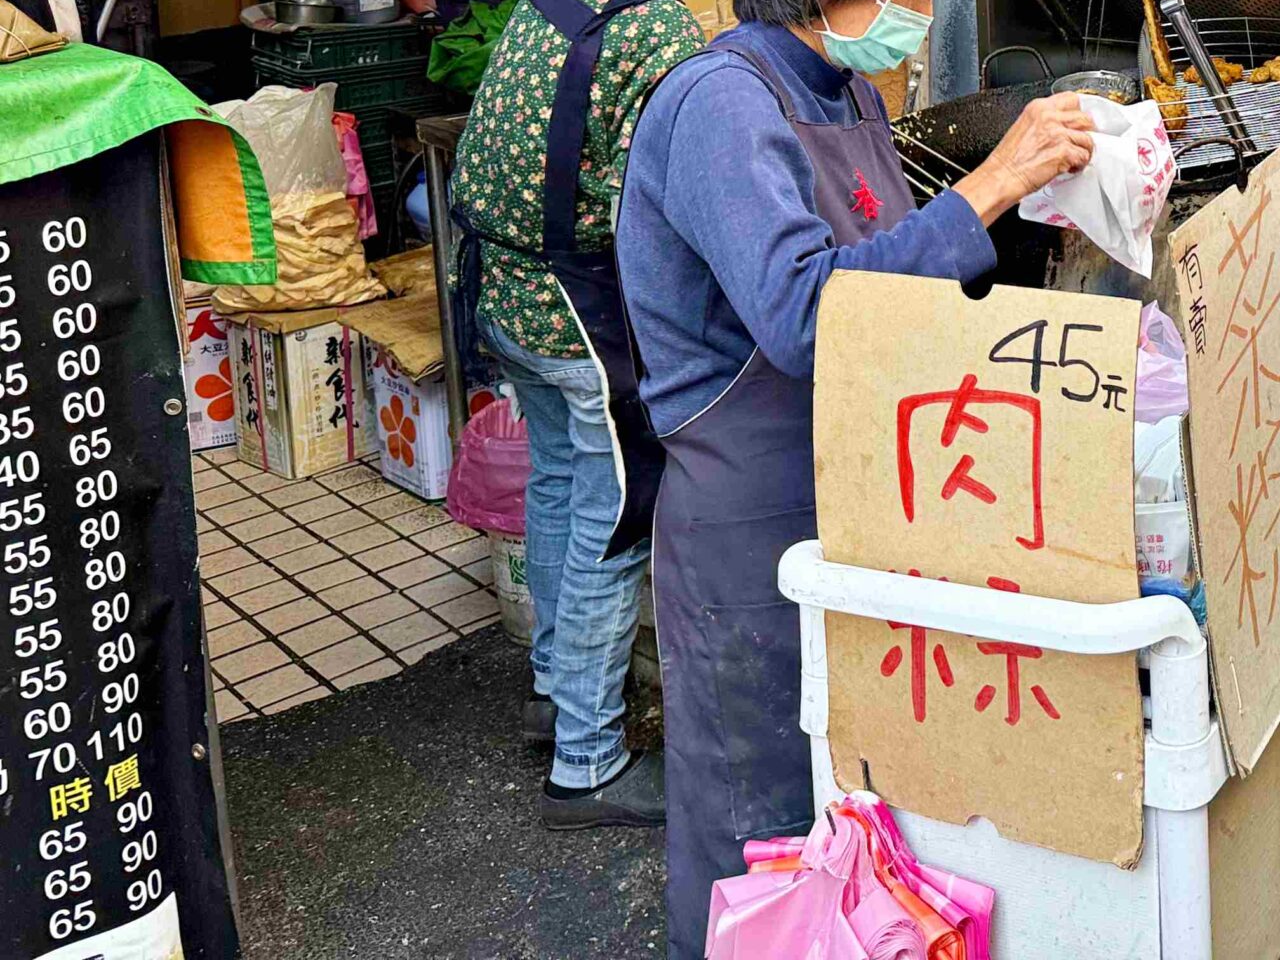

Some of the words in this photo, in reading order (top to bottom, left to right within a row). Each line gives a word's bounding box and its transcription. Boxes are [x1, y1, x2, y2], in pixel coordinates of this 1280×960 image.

[42, 217, 87, 253] 60
[47, 260, 92, 296] 60
[52, 303, 98, 339] 60
[57, 344, 101, 382] 60
[988, 319, 1128, 413] 45元
[62, 386, 105, 424] 60
[69, 427, 112, 466] 65
[0, 492, 46, 531] 55
[75, 469, 118, 508] 80
[4, 535, 51, 574] 55
[79, 510, 120, 549] 80
[9, 577, 57, 616] 55
[85, 551, 126, 590] 80
[15, 618, 62, 658] 55
[91, 592, 130, 632] 80
[20, 660, 68, 700] 55
[97, 632, 136, 673] 80
[24, 702, 72, 740] 60
[102, 672, 140, 714] 90
[28, 742, 77, 781] 70
[87, 712, 143, 761] 110
[39, 821, 87, 861] 65
[117, 791, 153, 834] 90
[44, 861, 92, 901] 65
[122, 830, 158, 873] 90
[49, 900, 97, 940] 65
[126, 869, 163, 912] 90
